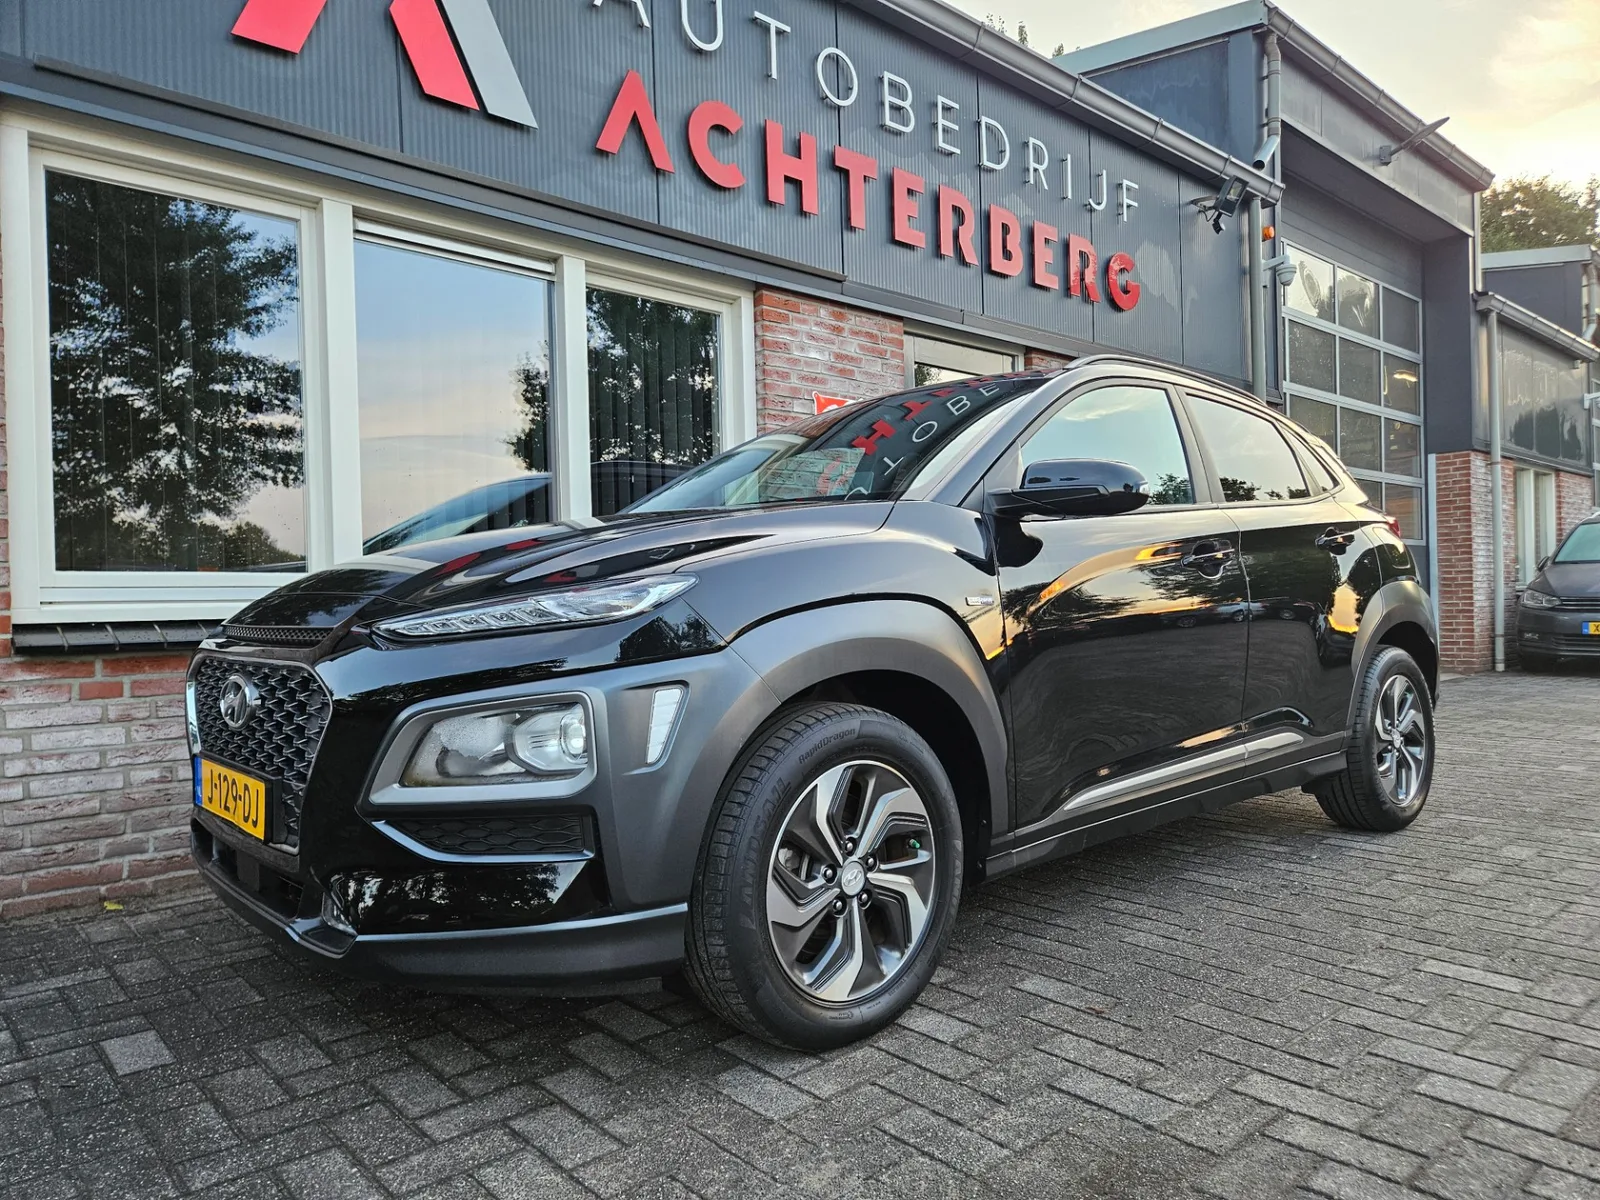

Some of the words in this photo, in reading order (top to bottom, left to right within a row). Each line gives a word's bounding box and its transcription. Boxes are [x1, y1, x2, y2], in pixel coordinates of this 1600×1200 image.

[596, 70, 1140, 310] ACHTERBERG
[798, 728, 856, 764] RapidDragon
[207, 768, 259, 829] J-129-DJ
